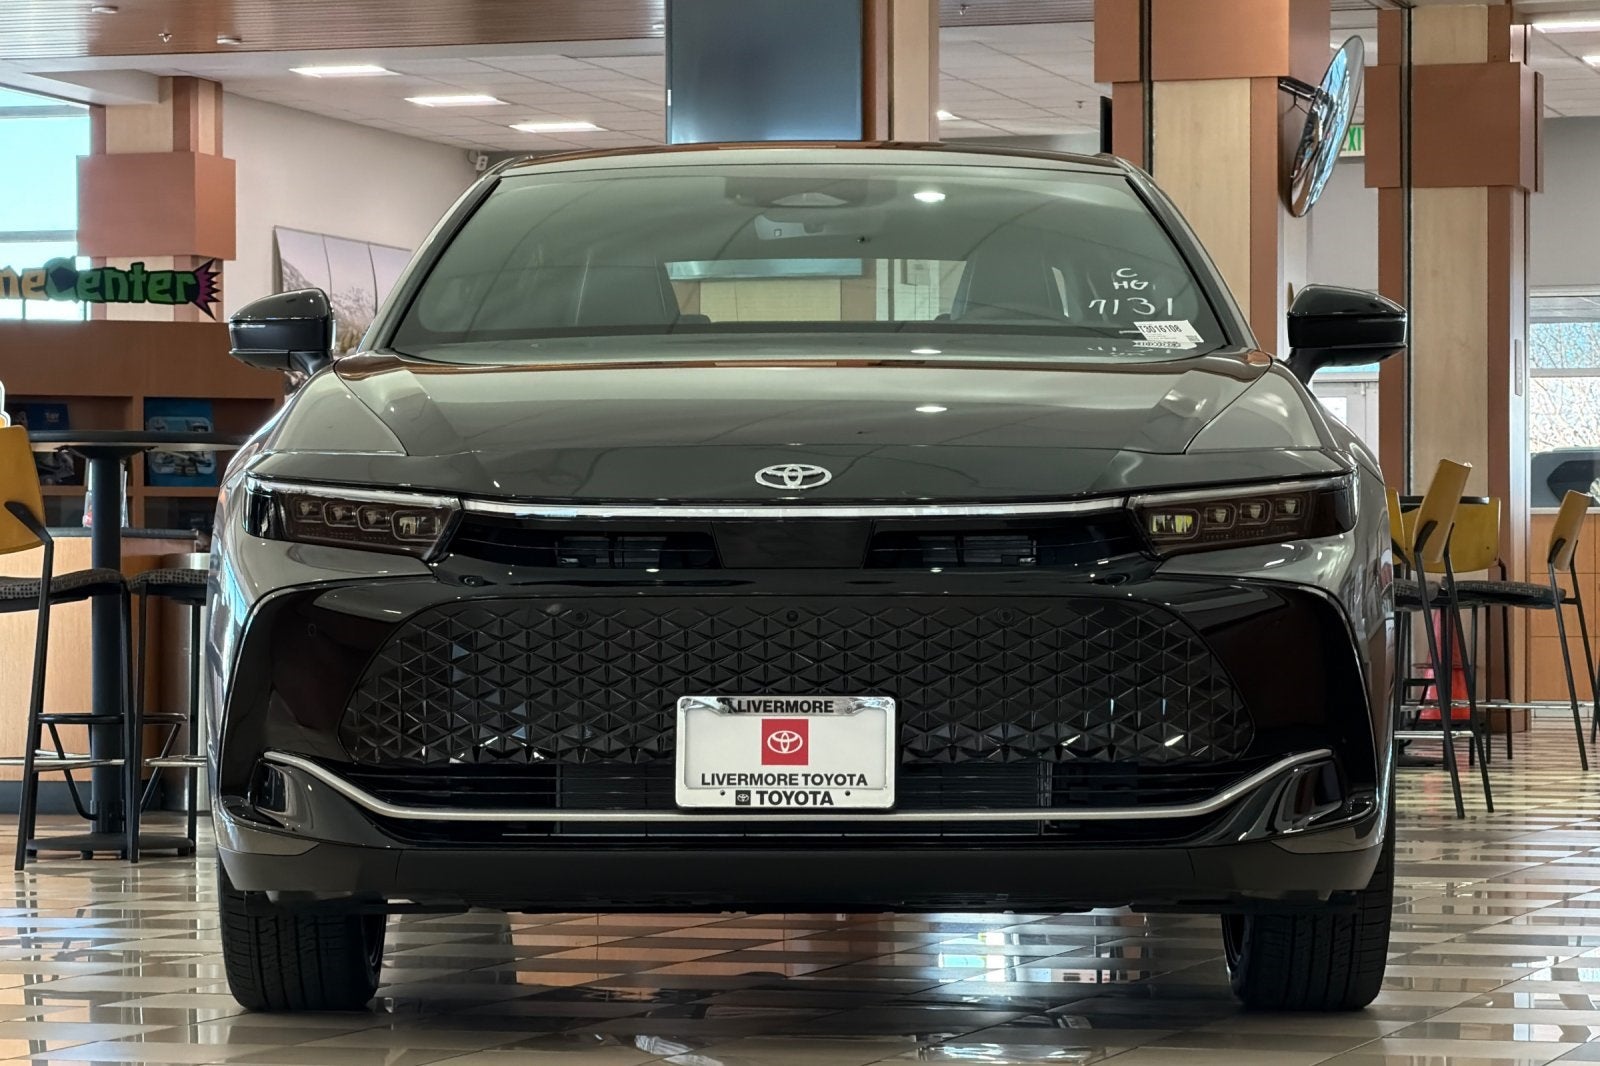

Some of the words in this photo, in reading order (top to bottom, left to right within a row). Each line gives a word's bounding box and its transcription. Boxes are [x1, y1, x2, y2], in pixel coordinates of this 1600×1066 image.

[738, 700, 834, 713] LIVERMORE
[701, 773, 799, 786] LIVERMORE
[801, 773, 868, 786] TOYOTA
[756, 790, 834, 806] TOYOTA
